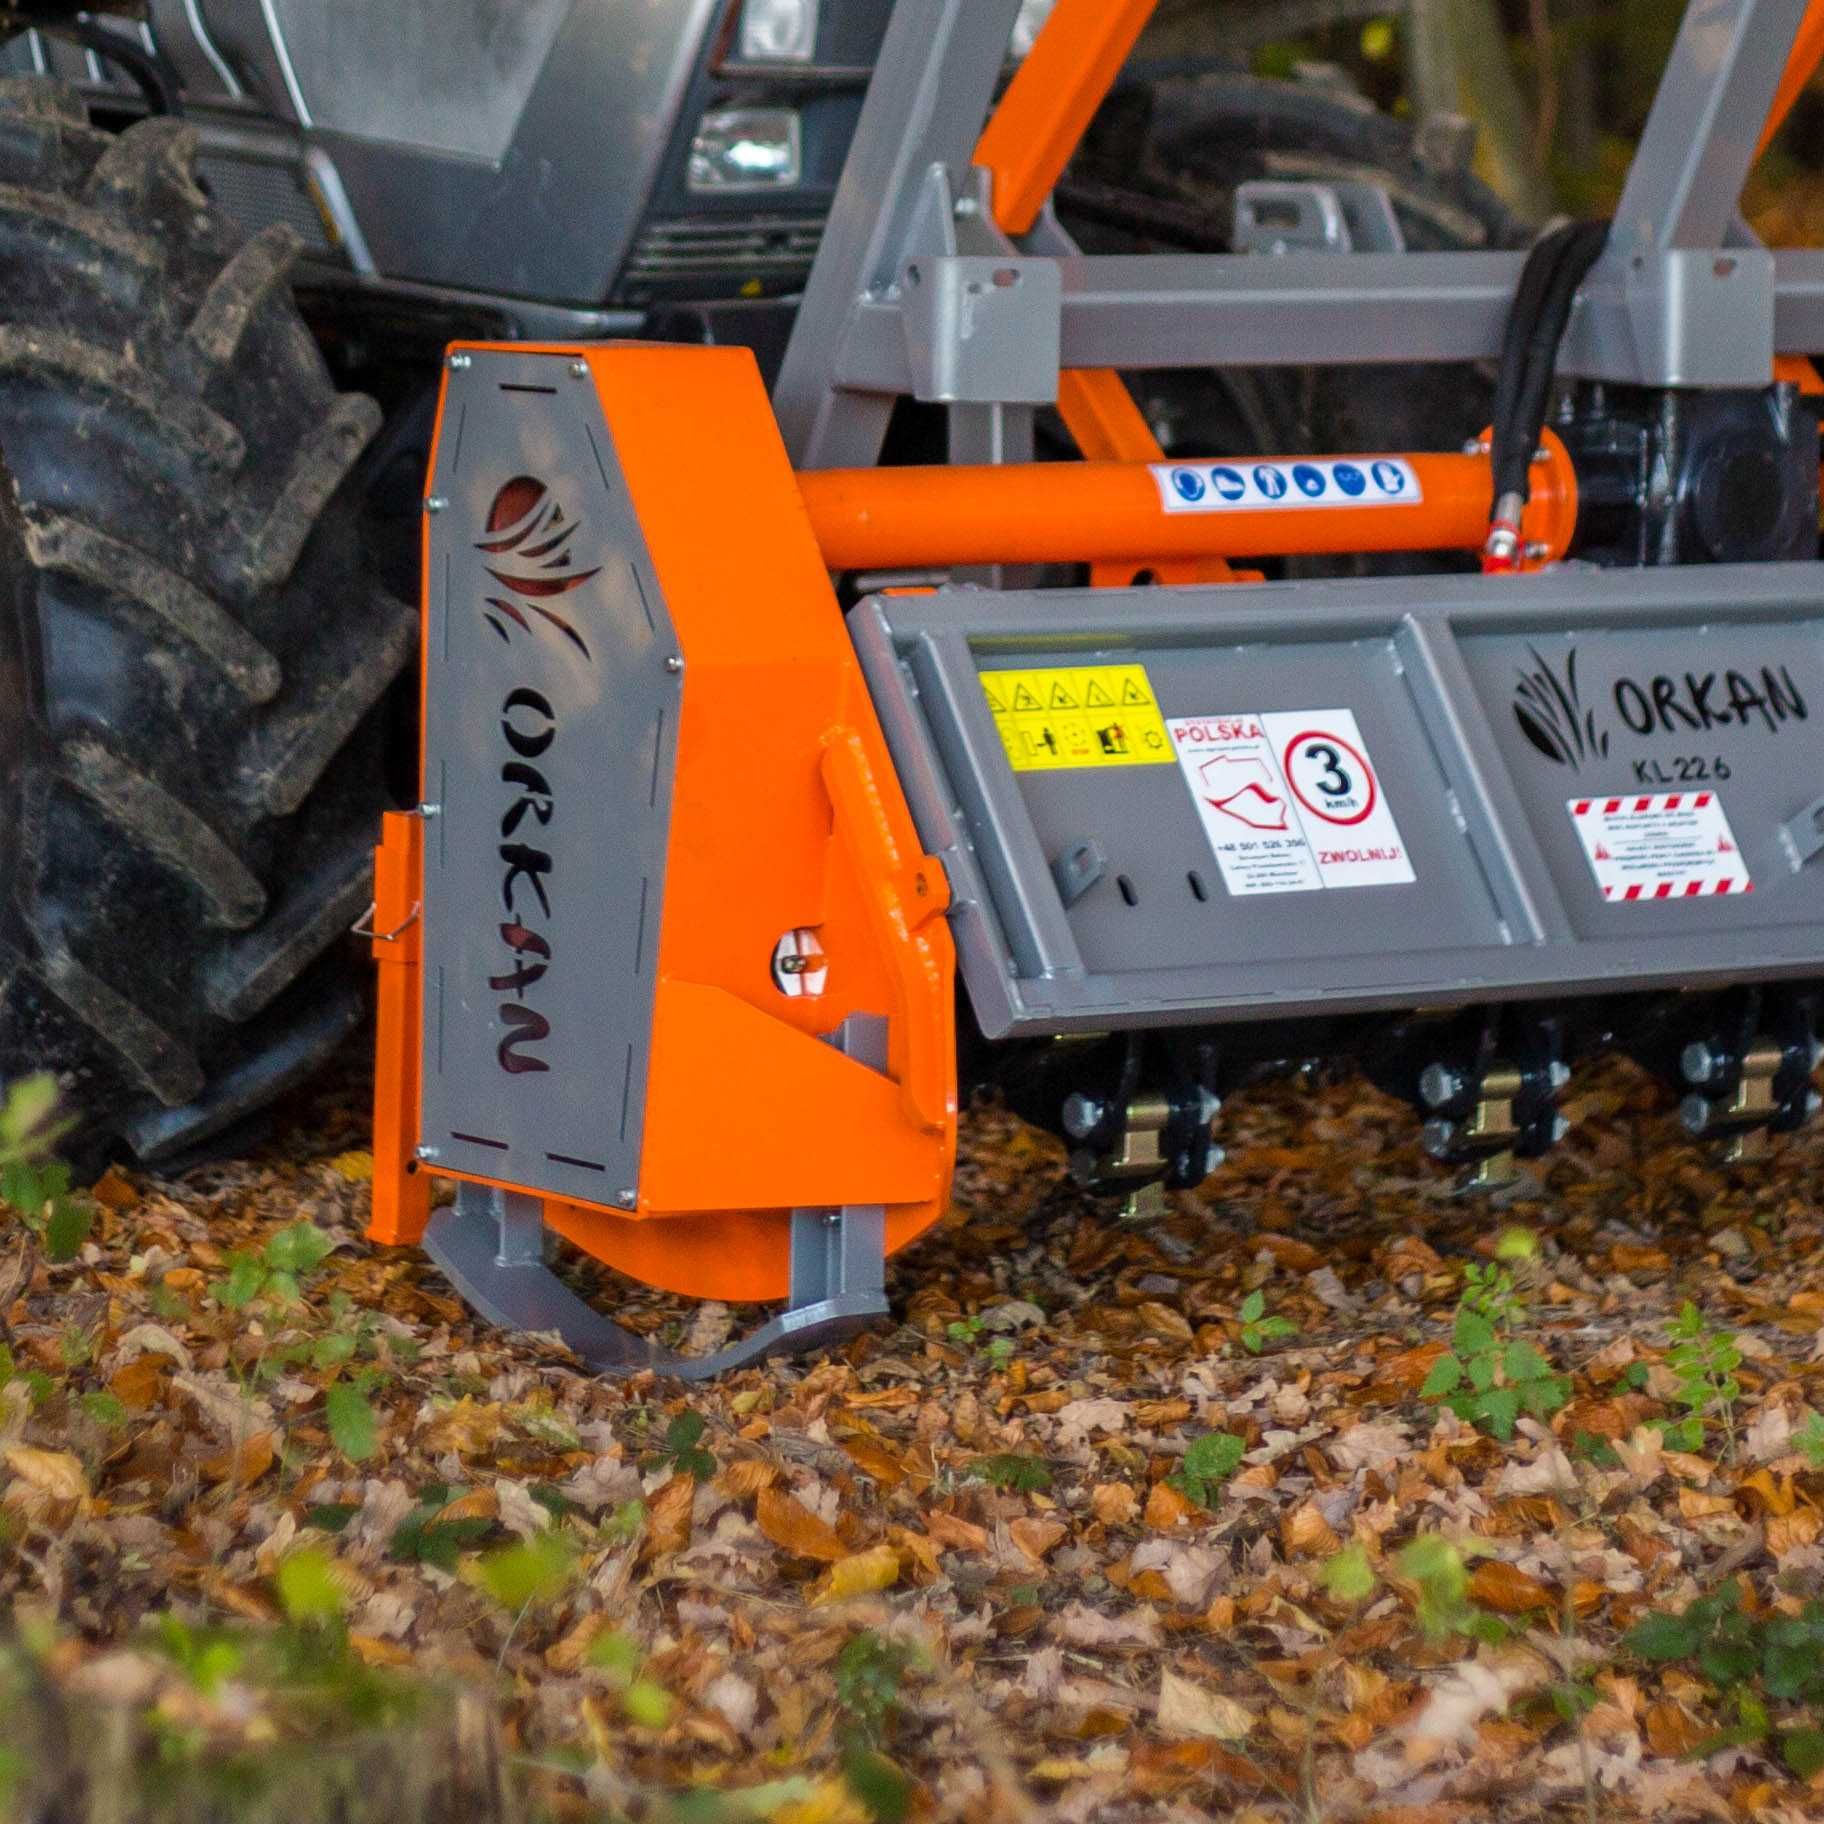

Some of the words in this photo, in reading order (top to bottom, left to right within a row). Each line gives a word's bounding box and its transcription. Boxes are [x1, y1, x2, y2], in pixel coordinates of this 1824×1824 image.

[1614, 665, 1809, 734] ORKAN
[1173, 723, 1265, 743] POLSKA
[1304, 742, 1353, 796] 3
[1632, 755, 1732, 784] KL226
[1325, 797, 1359, 809] km/h
[489, 687, 556, 1074] ORKAN
